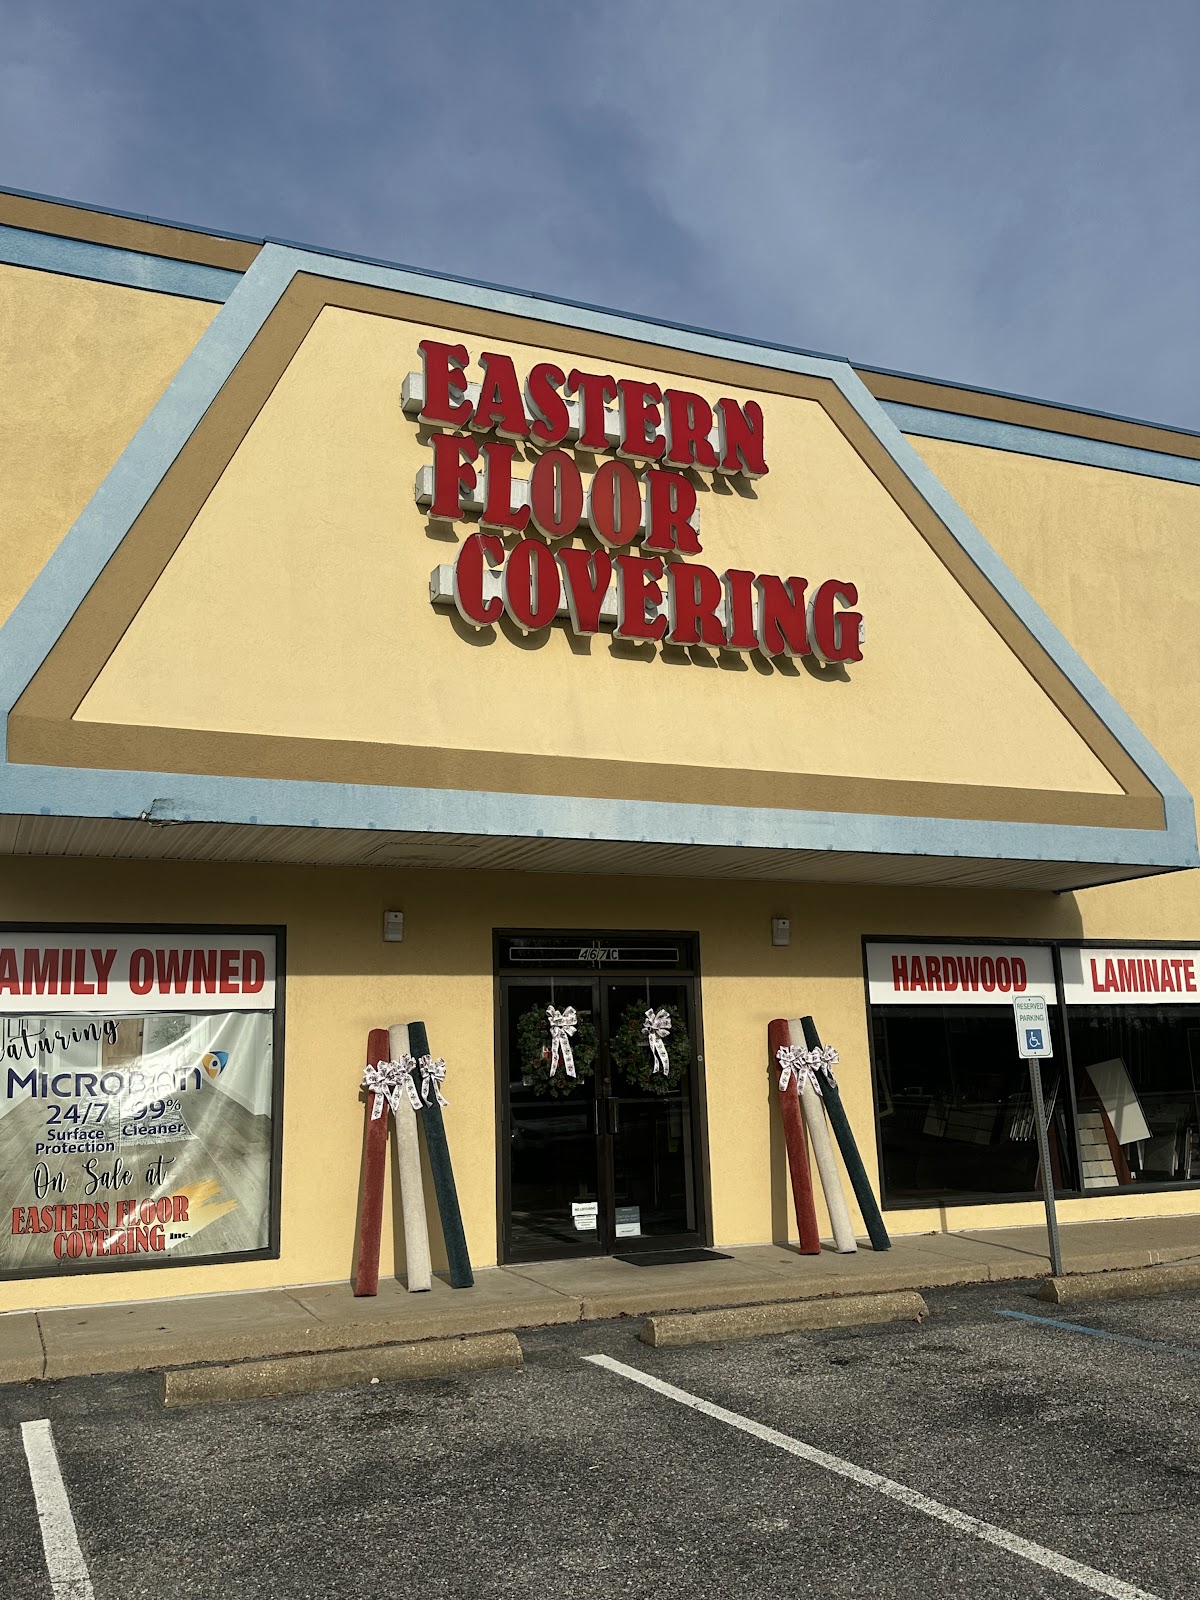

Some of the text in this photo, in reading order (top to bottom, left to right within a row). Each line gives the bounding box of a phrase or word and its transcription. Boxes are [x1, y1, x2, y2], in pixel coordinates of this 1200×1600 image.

[419, 340, 769, 479] EASTERN
[428, 434, 703, 555] FLOOR
[454, 533, 864, 664] COVERING
[129, 949, 266, 995] OWNED
[891, 955, 1028, 992] HARDWOOD
[1089, 958, 1198, 993] LAMINATE
[1016, 1002, 1044, 1010] RESERVED
[1019, 1014, 1045, 1022] PARKING
[0, 1019, 120, 1061] aturing
[46, 1103, 109, 1125] 24/7
[47, 1122, 184, 1141] Surface Cleaner
[35, 1141, 115, 1155] Protection
[33, 1155, 176, 1200] On Sale at
[11, 1195, 190, 1235] EASTERN FLOOR
[53, 1224, 192, 1260] COVERING Inc.
